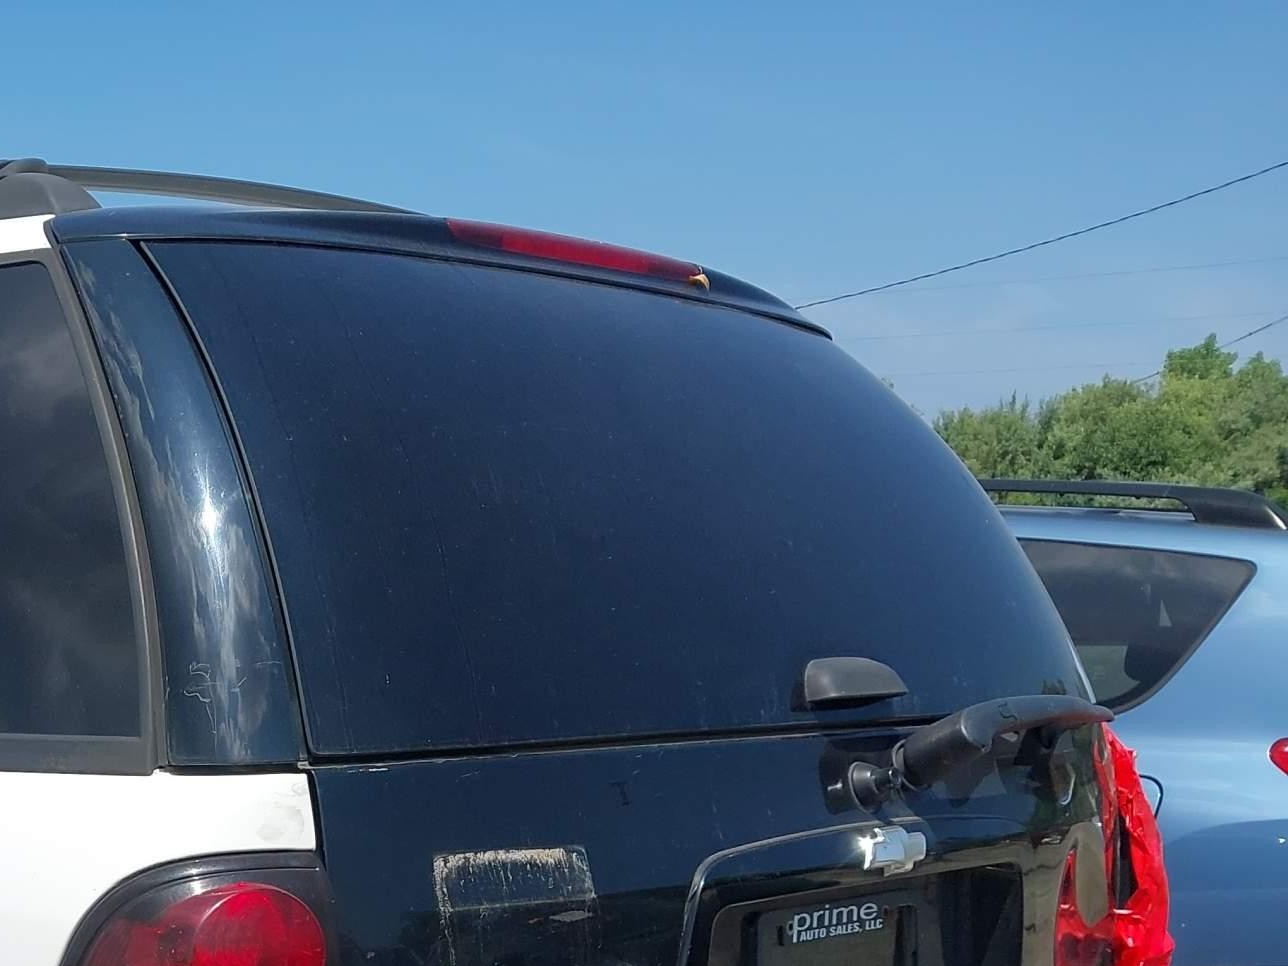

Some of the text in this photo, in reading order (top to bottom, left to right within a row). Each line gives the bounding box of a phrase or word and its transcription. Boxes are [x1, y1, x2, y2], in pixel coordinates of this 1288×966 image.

[791, 902, 879, 944] prime
[799, 918, 884, 942] AUTO SALES, LLC
